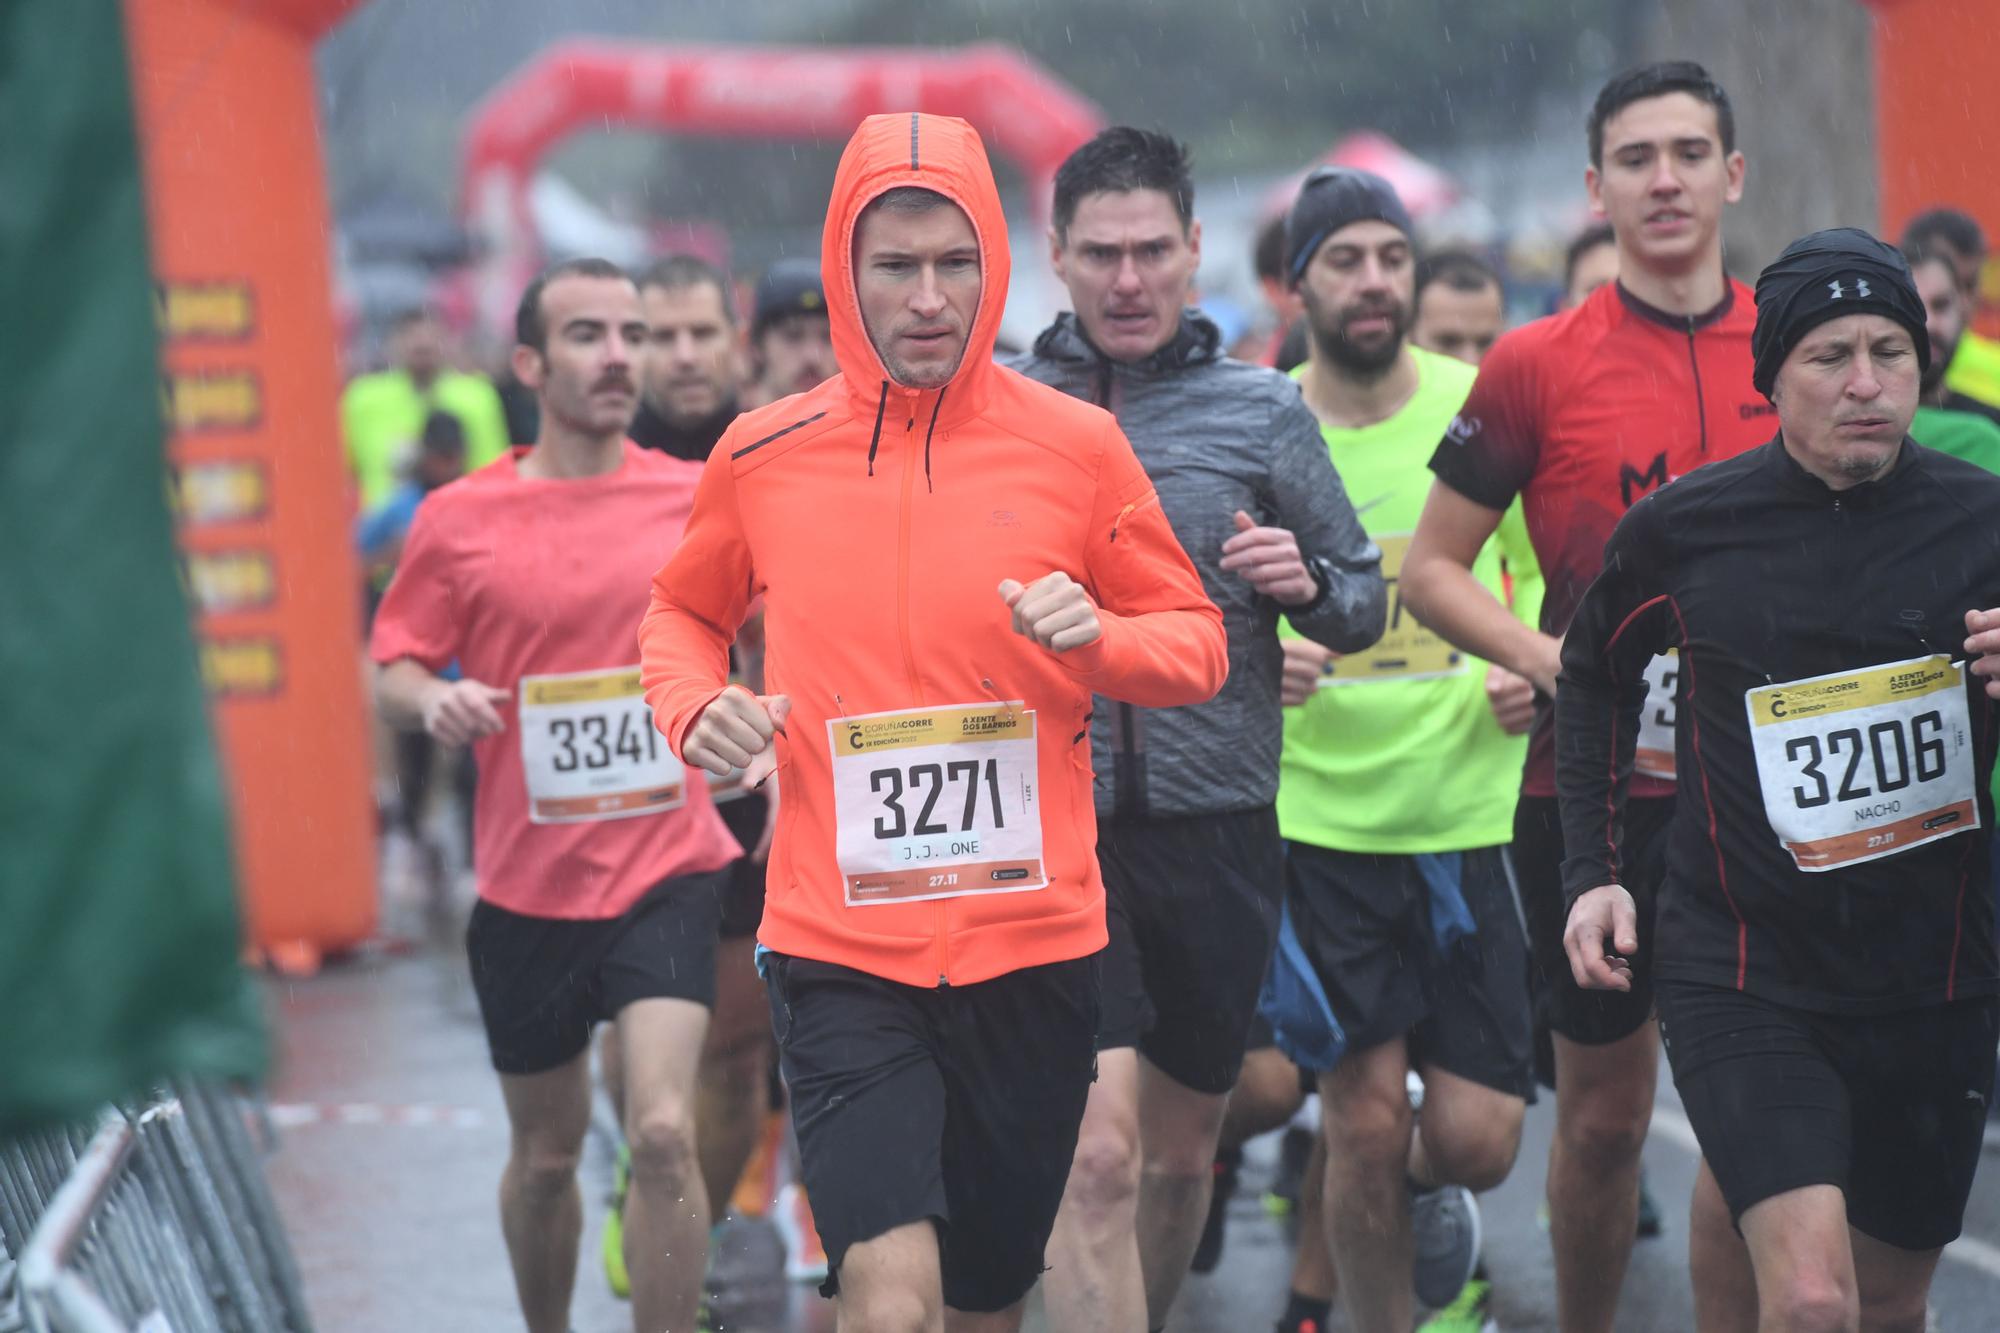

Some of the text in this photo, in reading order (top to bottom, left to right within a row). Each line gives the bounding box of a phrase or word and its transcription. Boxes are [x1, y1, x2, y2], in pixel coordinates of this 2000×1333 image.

[962, 720, 1017, 731] DOS BARRIOS
[970, 715, 997, 723] XENTE
[1785, 710, 1946, 809] 3206
[870, 758, 1005, 840] 3271
[1854, 800, 1901, 822] NACHO
[904, 840, 980, 860] J.J. ONE
[928, 873, 959, 887] 27.11
